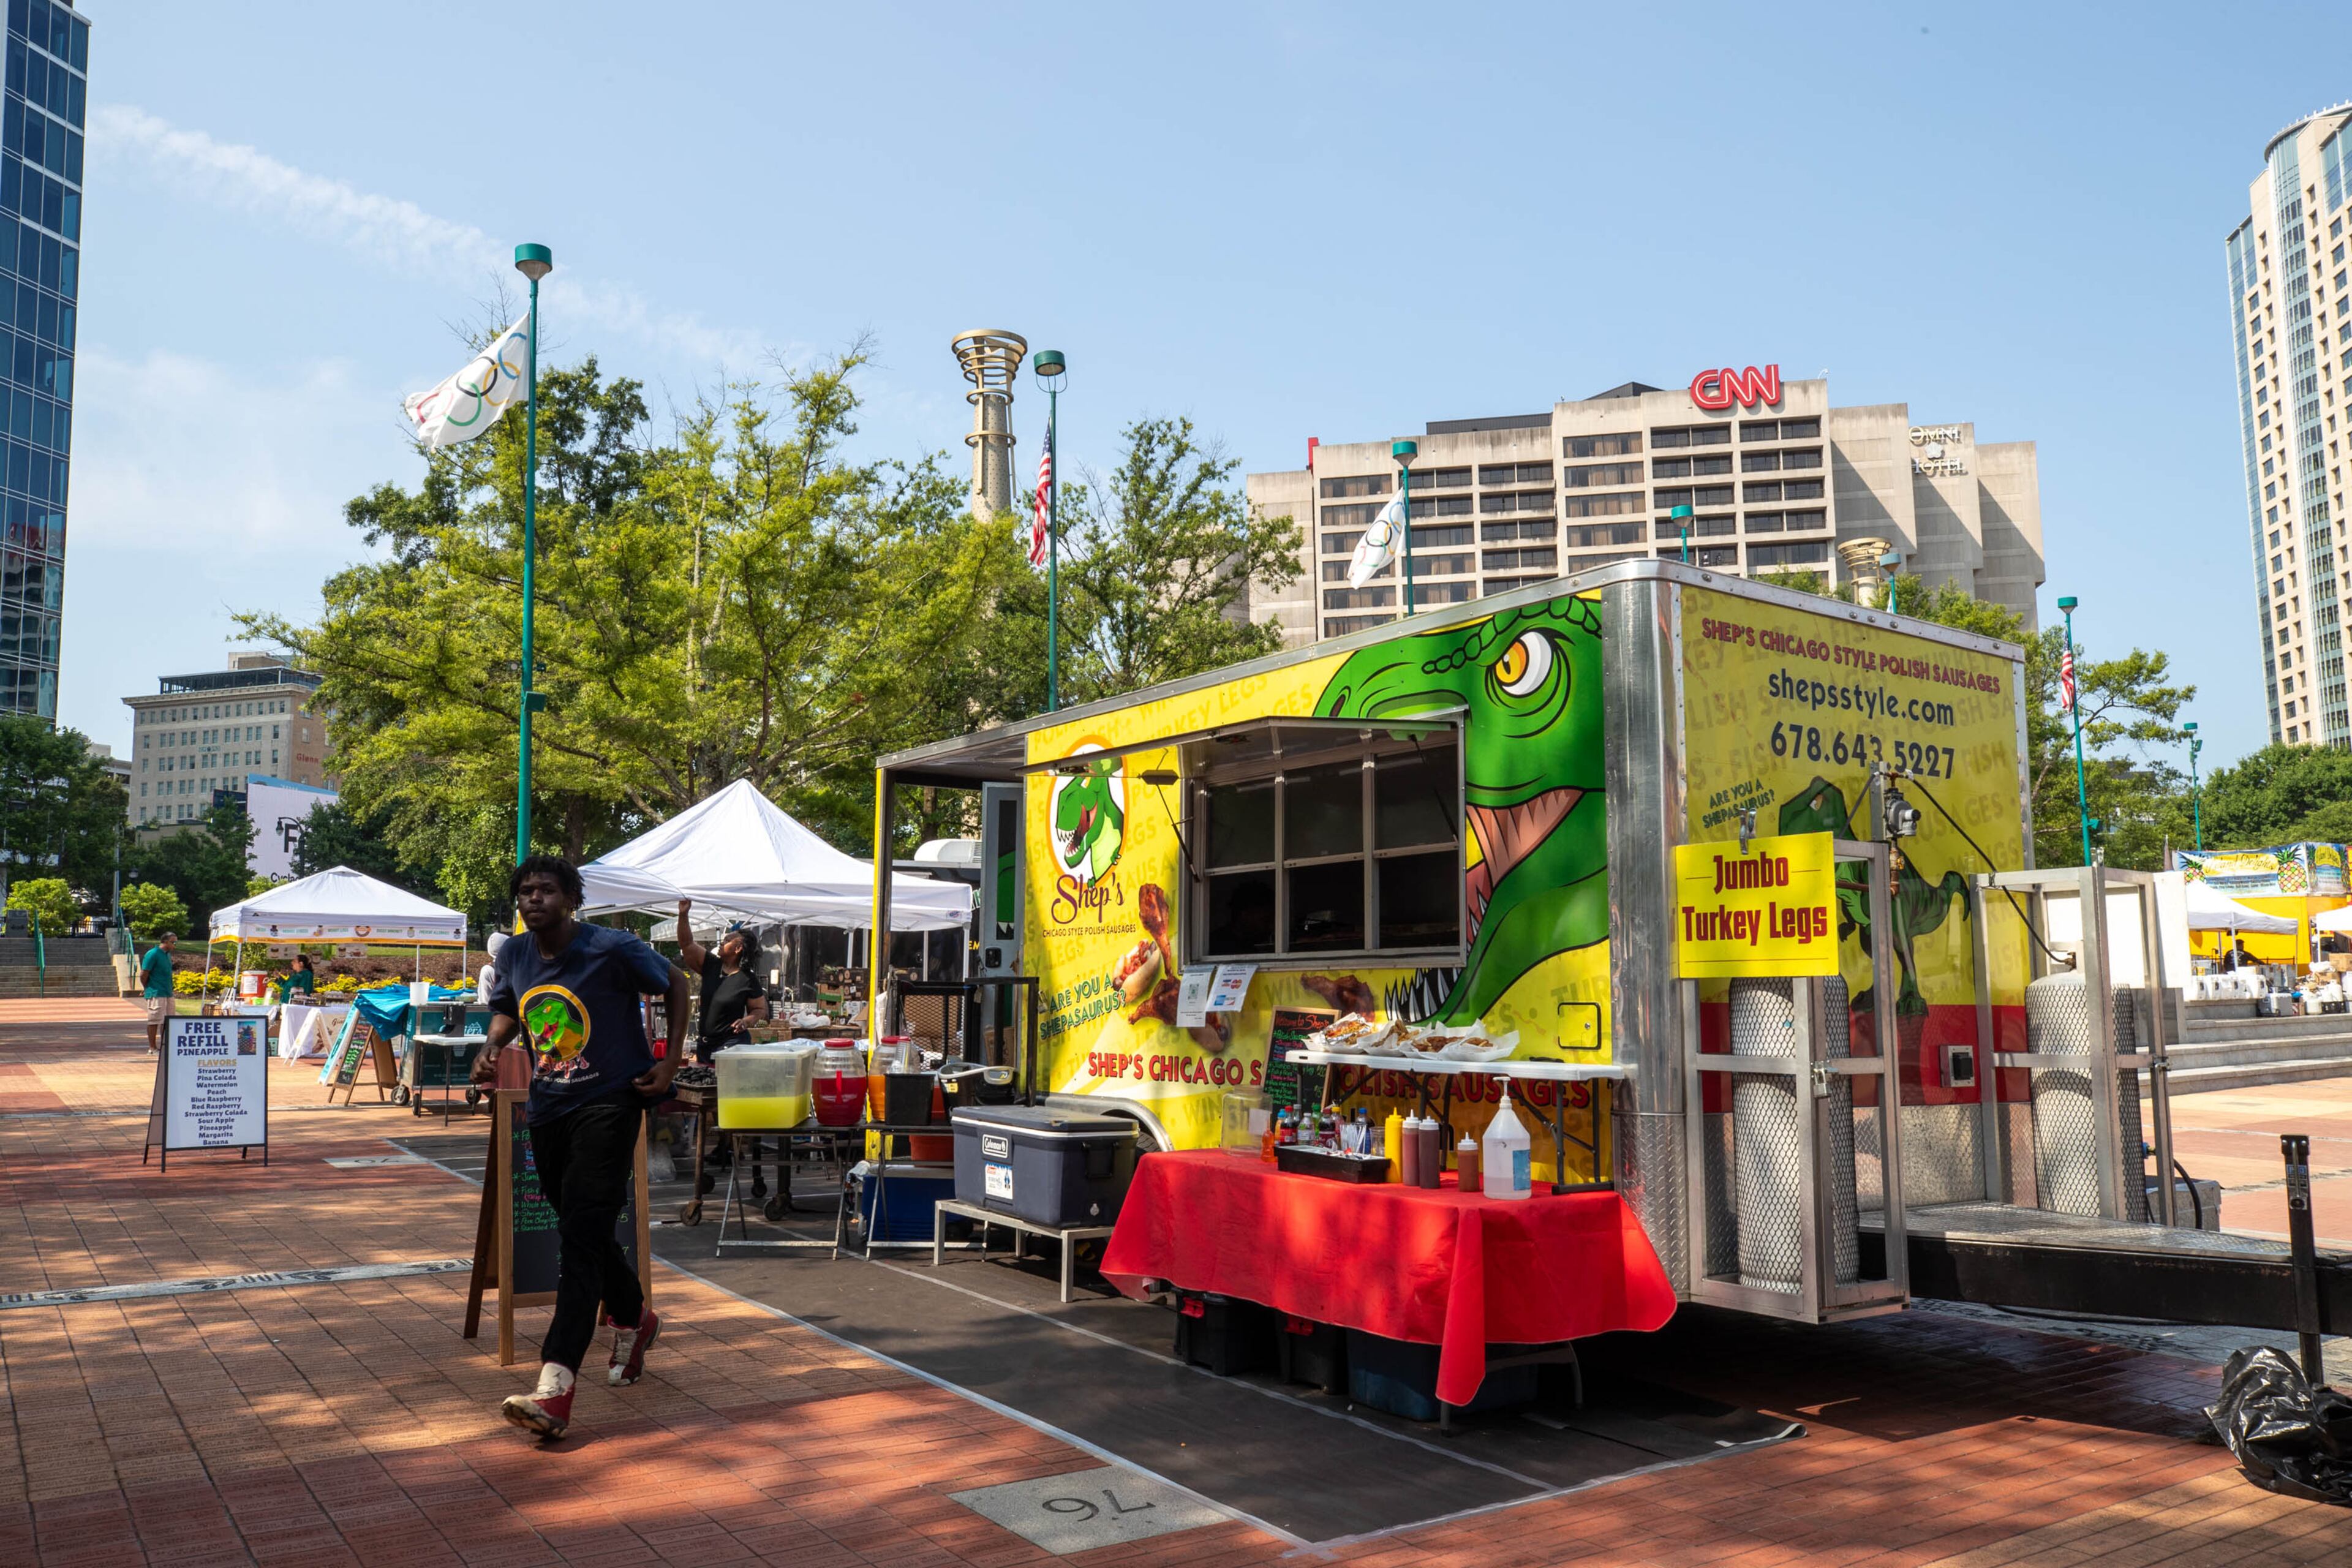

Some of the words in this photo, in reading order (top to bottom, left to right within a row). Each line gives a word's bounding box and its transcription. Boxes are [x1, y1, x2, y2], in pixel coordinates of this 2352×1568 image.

[1691, 364, 1780, 410] CNN
[1909, 426, 1960, 442] OMNI
[1702, 617, 1755, 647] SHEP'S
[1759, 630, 1830, 662] CHICAGO
[1834, 645, 1877, 673] STYLE
[1880, 654, 1929, 680] POLISH
[1932, 665, 2000, 694] SAUSAGES
[1769, 668, 1954, 726] shepsstyle.com
[1771, 721, 1954, 779] 678.643.5227
[1702, 788, 1775, 829] SHEPASAURUS?
[1709, 790, 1730, 809] ARE
[1730, 781, 1754, 798] YOU
[1755, 778, 1764, 790] A
[1713, 851, 1789, 894] Jumbo
[1051, 872, 1124, 924] Shep's
[1042, 927, 1066, 938] CHICAGO
[1085, 925, 1105, 935] POLISH
[1107, 924, 1136, 934] SAUSAGES
[1682, 904, 1761, 946] Turkey
[1769, 902, 1828, 944] Legs
[1049, 989, 1072, 1014] ARE
[1074, 976, 1100, 1003] YOU
[1104, 973, 1114, 990] A
[185, 1022, 221, 1034] FREE
[1040, 989, 1127, 1039] SHEPASAURUS?
[178, 1035, 228, 1047] REFILL
[197, 1058, 237, 1067] FLAVORS
[571, 1072, 600, 1084] SAUSAGES
[1088, 1052, 1144, 1080] SHEP'S
[1149, 1054, 1244, 1085] CHICAGO
[1338, 1063, 1408, 1099] OLISH
[985, 1138, 1002, 1150] Coleman
